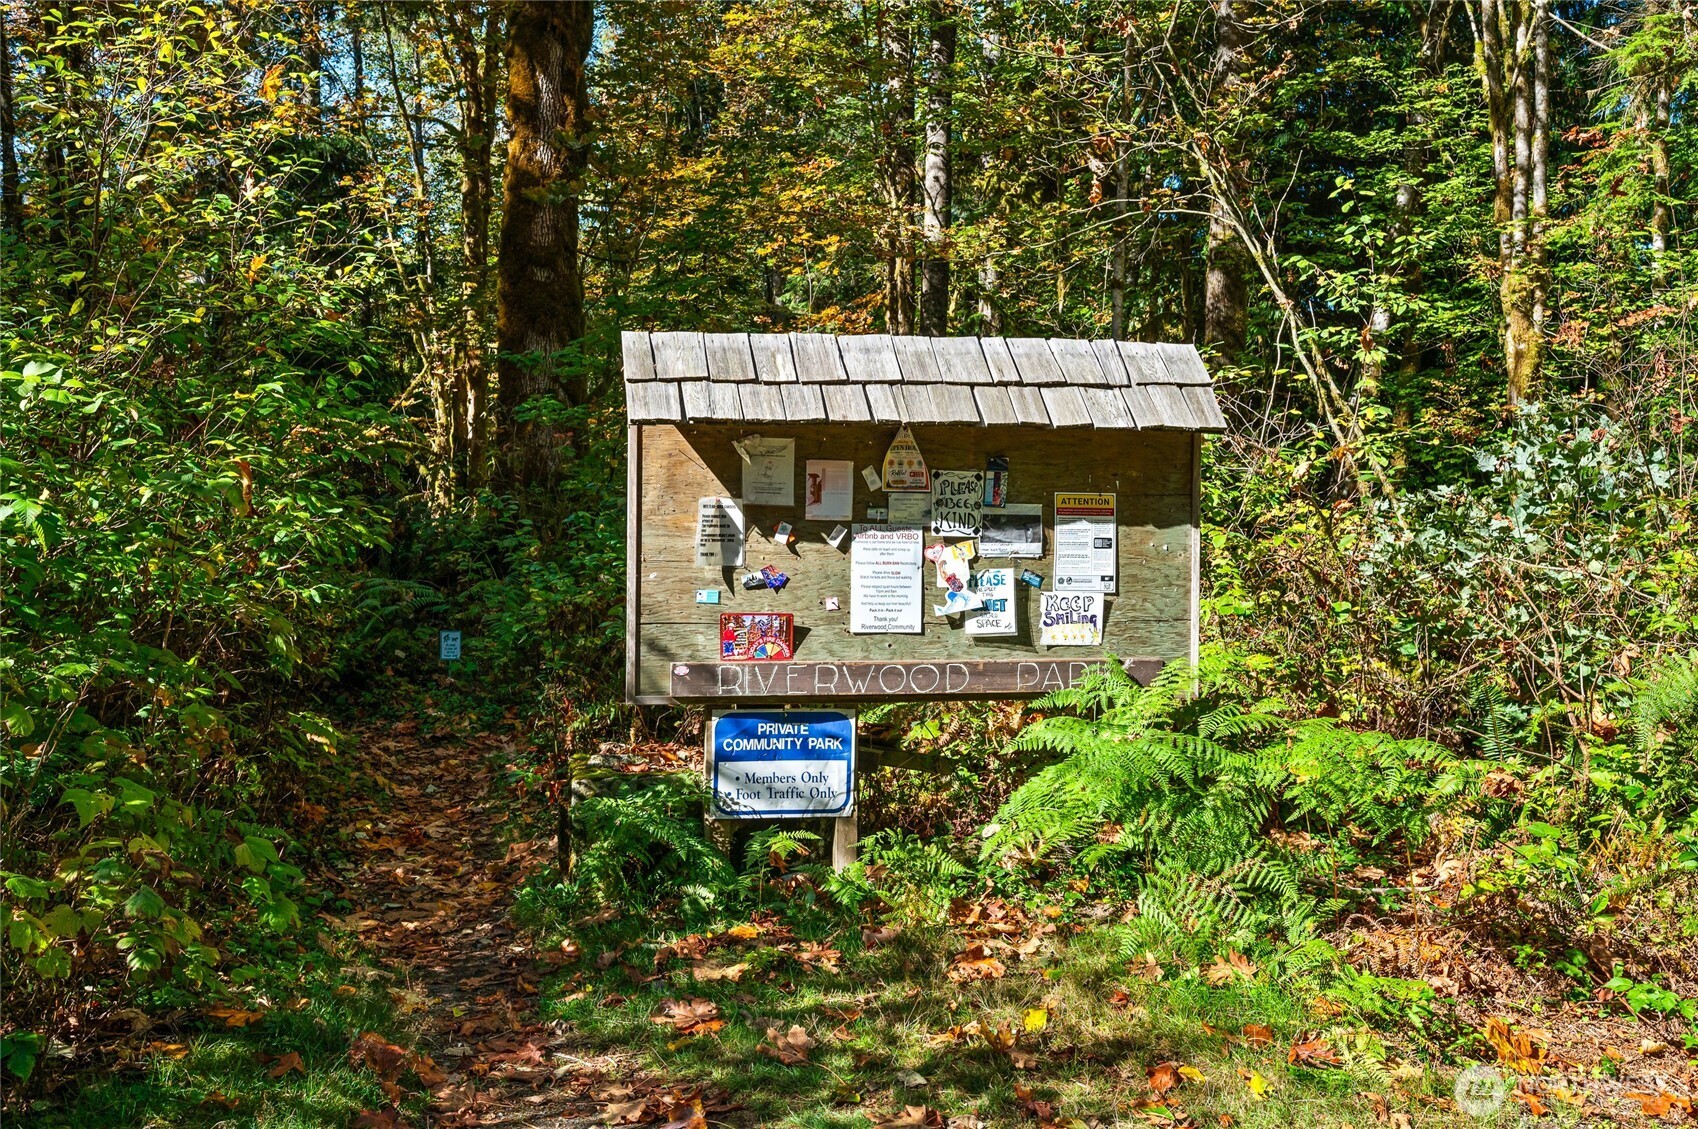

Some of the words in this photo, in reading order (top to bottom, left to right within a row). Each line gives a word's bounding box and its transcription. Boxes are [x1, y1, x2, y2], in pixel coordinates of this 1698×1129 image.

[940, 480, 978, 496] PLEASE
[1060, 497, 1110, 506] ATTENTION
[940, 511, 977, 529] KIND
[860, 525, 868, 533] To
[870, 525, 884, 533] ALL
[968, 574, 1006, 588] PLEASE
[1046, 594, 1094, 612] KEEP
[976, 620, 1002, 628] SPACE
[775, 638, 791, 657] DANGER
[718, 662, 970, 695] RIVERWOOD
[1017, 661, 1111, 691] PAR
[758, 723, 809, 735] PRIVATE
[723, 738, 802, 751] COMMUNITY
[809, 738, 843, 751] PARK
[744, 772, 796, 785] Members
[801, 772, 829, 785] Only
[736, 787, 761, 800] Foot
[766, 787, 804, 800] Traffic
[810, 787, 838, 800] Only
